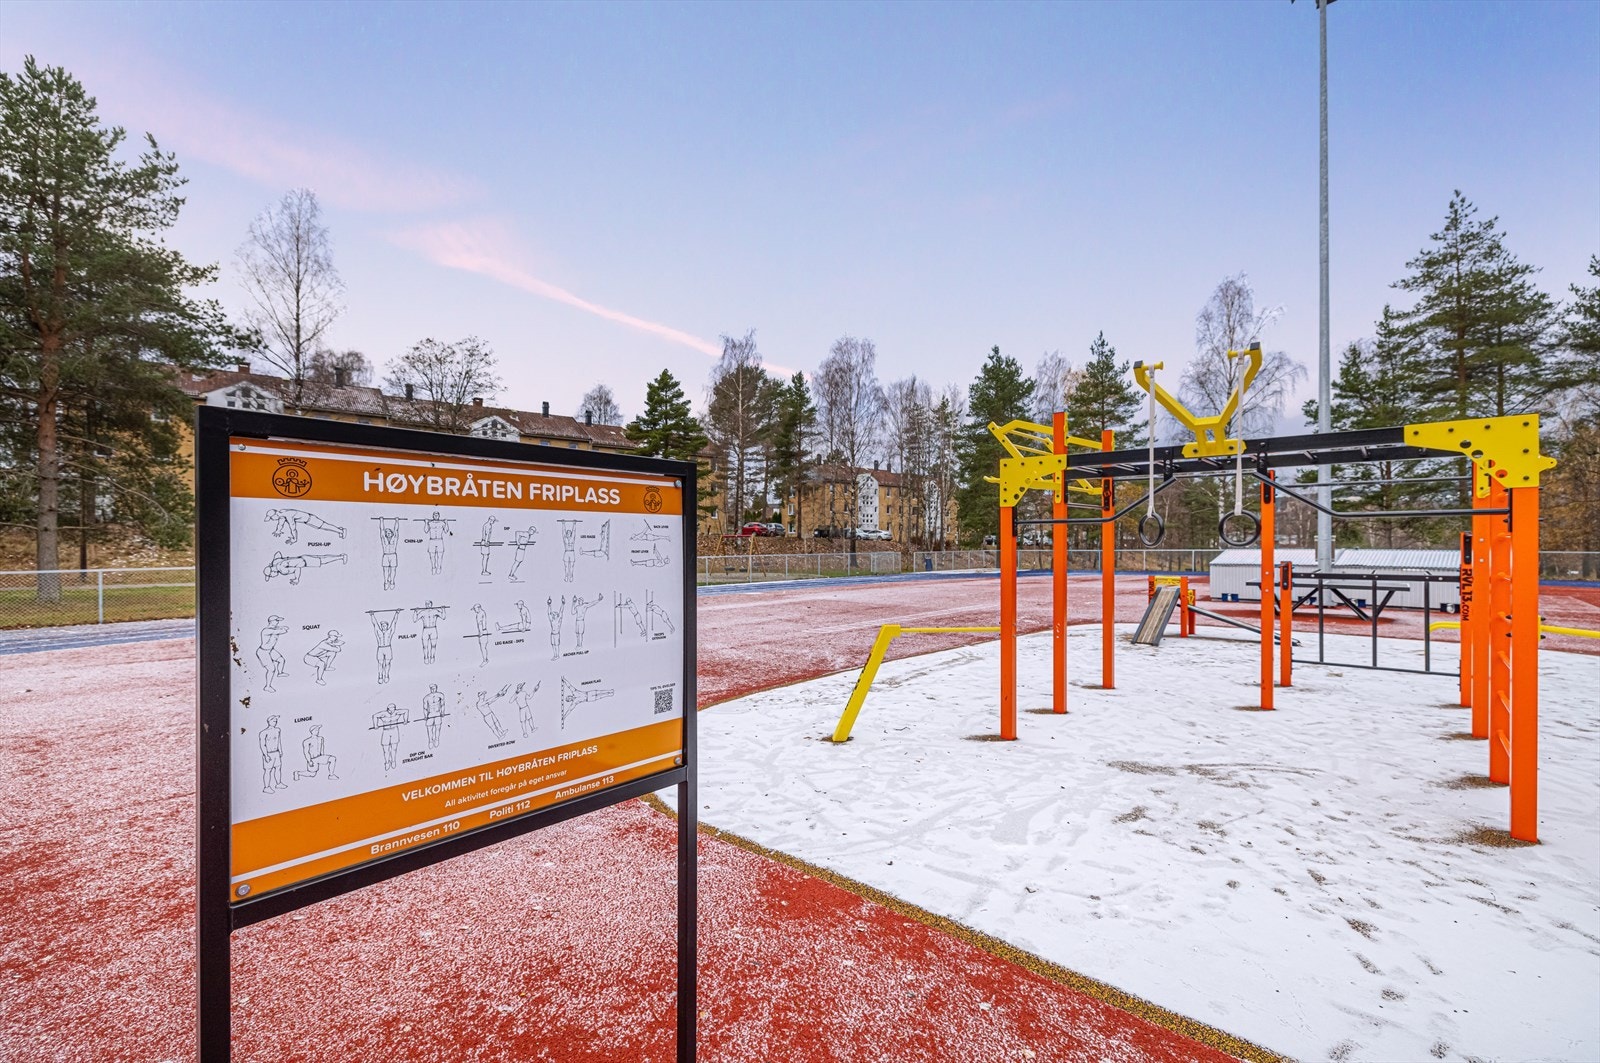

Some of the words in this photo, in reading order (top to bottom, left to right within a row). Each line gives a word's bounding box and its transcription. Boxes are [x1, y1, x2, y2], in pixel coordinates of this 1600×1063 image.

[363, 471, 522, 500] HØYBRÅTEN
[529, 483, 621, 505] FRIPLASS
[1461, 568, 1474, 621] RVL13.COM
[402, 756, 423, 764] STRAIGHT
[402, 775, 476, 802] VELKOMMEN
[479, 770, 493, 783] TIL
[496, 755, 556, 778] HØYBRÅTEN
[558, 745, 598, 762] FRIPLASS
[445, 798, 456, 808] All
[457, 790, 489, 806] aktivitet
[490, 783, 517, 799] foregår
[518, 779, 527, 790] på
[529, 775, 544, 788] eget
[545, 770, 567, 781] ansvar
[370, 827, 440, 855] Brannvesen
[443, 820, 460, 833] 110
[489, 805, 514, 819] Politi
[516, 800, 531, 811] 112
[555, 780, 601, 799] Ambulanse
[603, 776, 614, 786] 113
